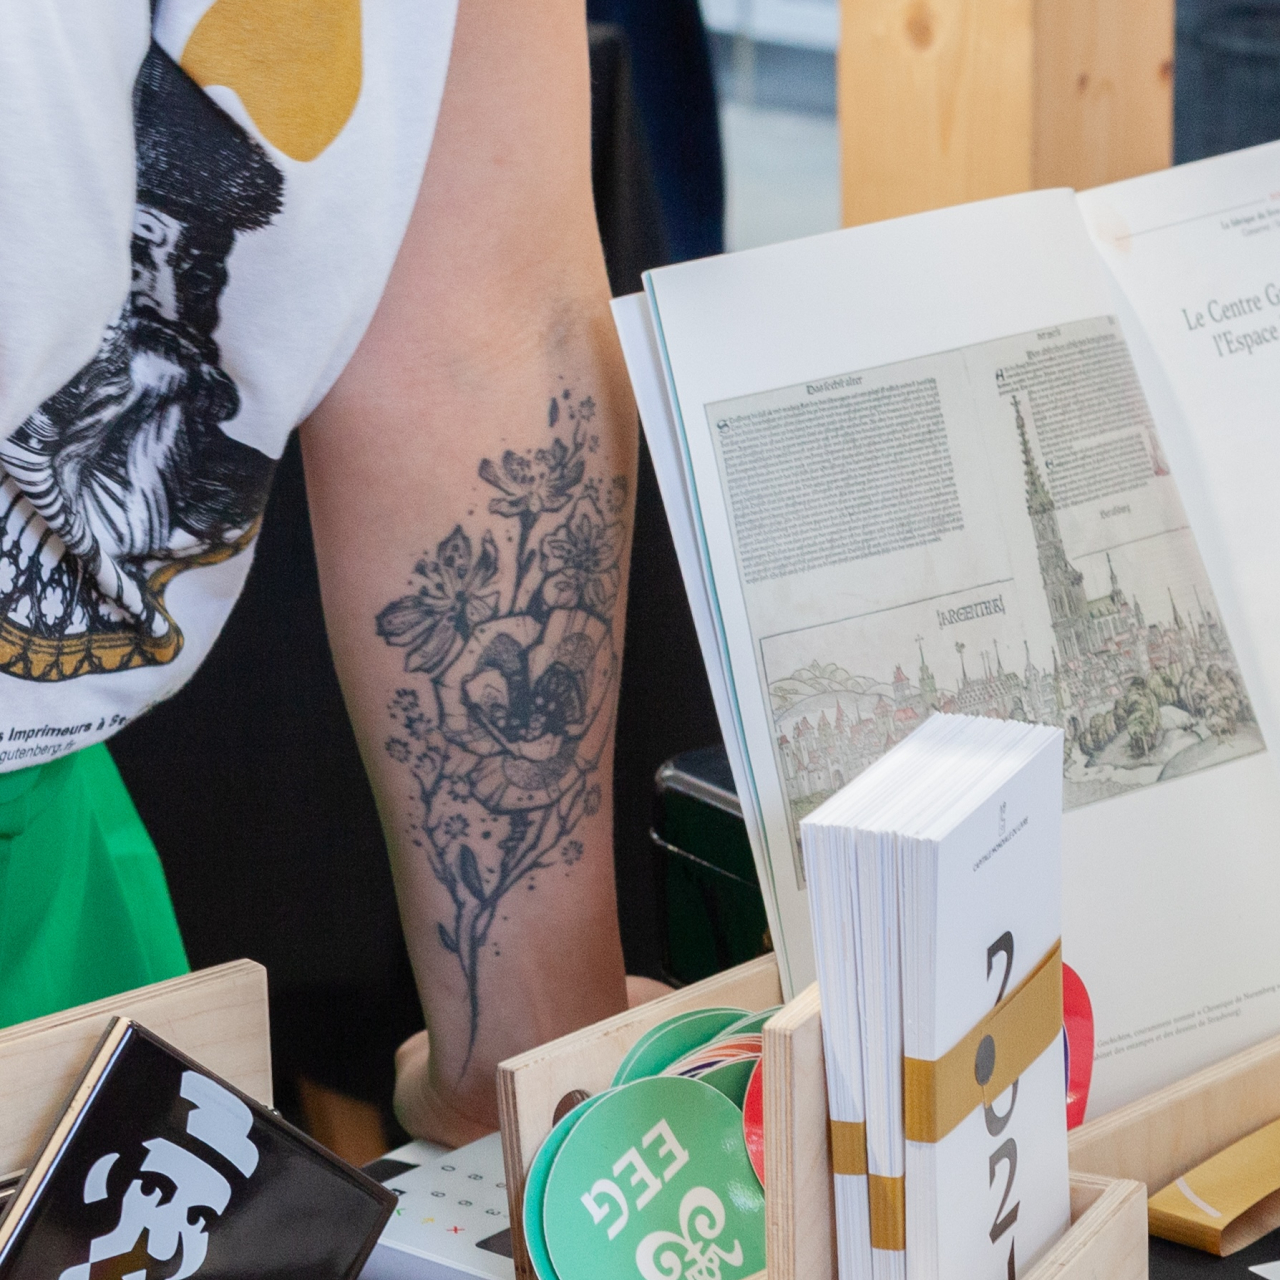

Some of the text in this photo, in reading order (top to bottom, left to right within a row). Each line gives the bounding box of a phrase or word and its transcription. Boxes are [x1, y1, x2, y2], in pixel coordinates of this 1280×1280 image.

[1181, 307, 1206, 332] Le
[1207, 291, 1264, 325] Centre
[1211, 320, 1280, 358] l'Espace
[8, 718, 93, 743] Imprimeurs
[579, 1117, 691, 1242] EEG
